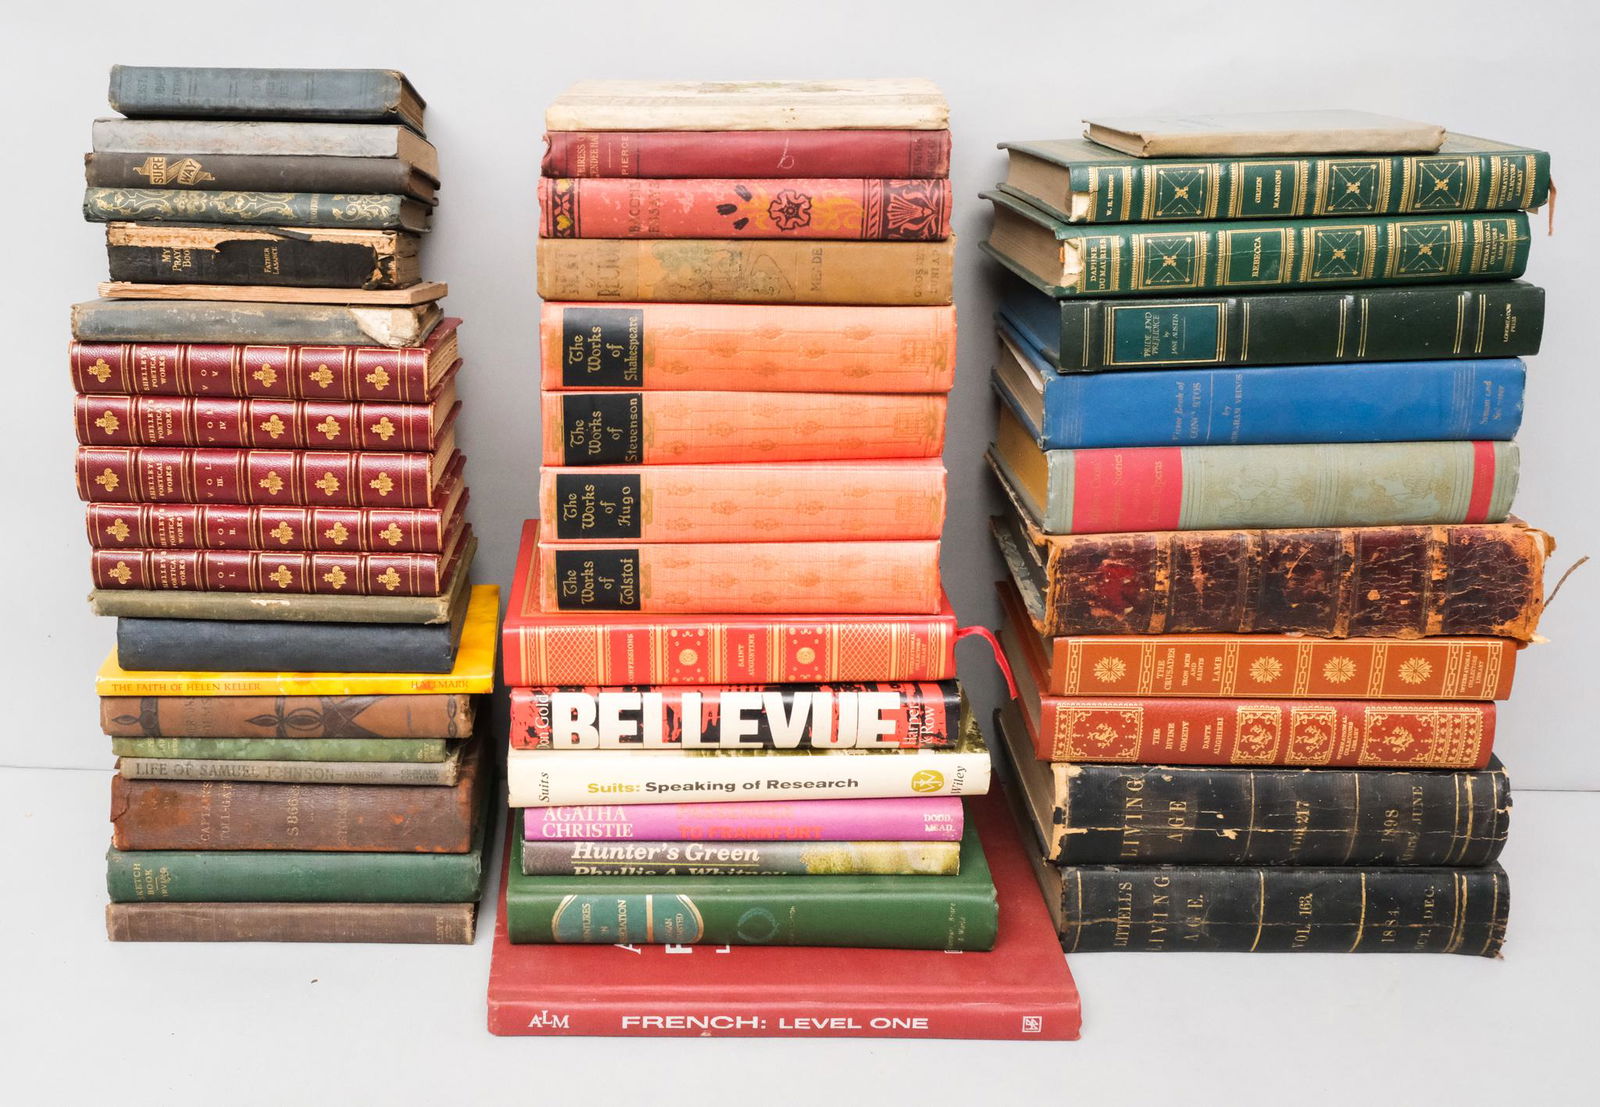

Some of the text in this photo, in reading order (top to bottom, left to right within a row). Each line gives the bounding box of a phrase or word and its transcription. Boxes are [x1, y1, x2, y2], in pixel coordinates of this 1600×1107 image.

[151, 157, 197, 184] SURE WAY
[621, 135, 629, 176] PIERCE
[1254, 176, 1262, 204] GREEN
[1272, 169, 1282, 209] MANSIONS
[1498, 157, 1508, 207] INTERNATIONAL
[1506, 163, 1516, 202] COLLECTORS
[1106, 207, 1113, 216] W.
[161, 248, 171, 263] MY
[173, 248, 181, 271] PRAY
[183, 250, 192, 267] BOO
[264, 247, 272, 273] FATHER
[1252, 236, 1261, 278] REBECCA
[1481, 222, 1490, 271] INTERNATIONAL
[1490, 227, 1498, 265] COLLECTORS
[1090, 246, 1098, 282] DAPHNE
[1099, 238, 1107, 289] DU MAURIER
[568, 334, 584, 365] The
[587, 325, 602, 374] Works
[606, 342, 624, 358] of
[624, 315, 640, 382] Shakespeare
[1143, 311, 1152, 358] PRIDE AND
[1151, 314, 1160, 356] PREJUDICE
[1162, 330, 1170, 338] by
[159, 355, 167, 384] WORKS
[1175, 381, 1184, 391] of
[1221, 405, 1231, 416] by
[569, 418, 584, 449] The
[588, 410, 602, 456] Works
[606, 425, 623, 441] of
[625, 397, 638, 463] Stevenson
[166, 465, 174, 494] WORKS
[1112, 454, 1123, 486] Stories
[1152, 460, 1164, 493] Operas
[563, 492, 578, 522] The
[582, 483, 595, 530] Works
[599, 499, 617, 514] of
[617, 485, 634, 527] Hugo
[563, 569, 578, 598] The
[580, 560, 594, 605] Works
[598, 575, 616, 591] of
[619, 557, 634, 606] Tolstoi
[626, 632, 635, 684] CONFESSIONS
[737, 643, 745, 668] SAINT
[748, 633, 756, 676] AUGUSTINE
[1156, 660, 1166, 679] THE
[1164, 647, 1176, 690] CRUSADES
[1196, 657, 1204, 681] SAINTS
[1212, 656, 1223, 682] LAMB
[112, 682, 261, 692] THE FAITH OF HELEN KELLER
[1460, 649, 1472, 693] INTERNATIONAL
[1468, 655, 1478, 689] COLLECTORS
[535, 694, 550, 729] Gold
[551, 692, 901, 749] BELLEVUE
[902, 701, 921, 746] Harper
[919, 704, 935, 744] & Row
[1153, 728, 1161, 745] THE
[1165, 722, 1175, 750] DIVINE
[1180, 720, 1190, 752] COMEDY
[1202, 724, 1212, 749] DANTE
[1214, 717, 1224, 755] ALIGHIERI
[1336, 715, 1348, 760] INTERNATIONAL
[136, 763, 335, 780] LIFE OF SAMUEL JOHNSON
[537, 771, 550, 803] Suits
[587, 777, 859, 796] Suits: Speaking of Research
[950, 766, 967, 795] Wiley
[221, 783, 232, 841] TOLL-GAT
[544, 806, 627, 822] AGATHA
[1120, 779, 1144, 857] LIVING
[1295, 800, 1310, 824] 217
[1411, 785, 1424, 824] JUNE
[542, 823, 633, 838] CHRISTIE
[679, 826, 824, 840] TO FRANKFURT
[1167, 800, 1187, 843] AGE
[1381, 808, 1399, 843] 1898
[571, 842, 760, 861] Hunter's Green
[133, 863, 144, 897] KETCH
[144, 868, 155, 896] BOOK
[1113, 881, 1133, 947] LITTELL'S
[1145, 876, 1170, 951] LIVING
[1423, 885, 1435, 920] DEC.
[621, 1016, 929, 1030] FRENCH: LEVEL ONE
